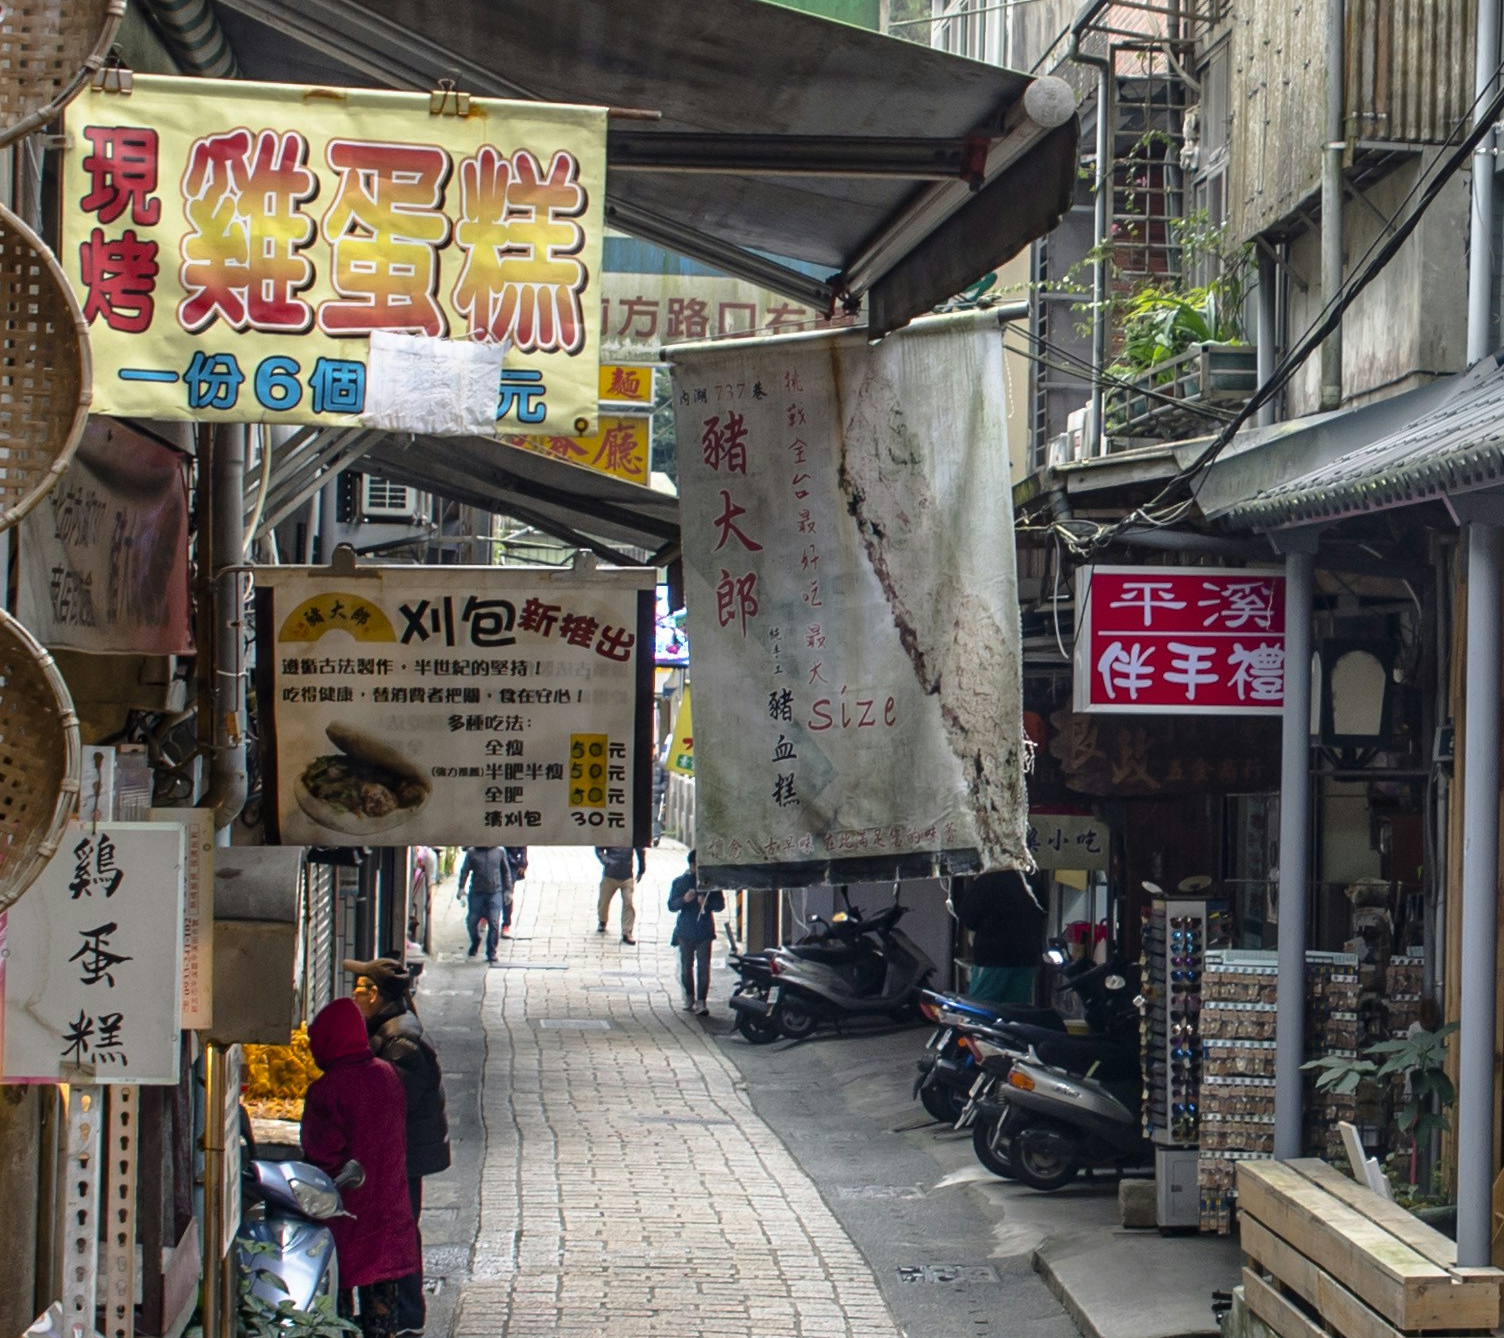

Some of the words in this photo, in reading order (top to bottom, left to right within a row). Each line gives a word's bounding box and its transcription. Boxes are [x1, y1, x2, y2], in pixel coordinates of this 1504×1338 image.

[79, 124, 161, 334] 現烤
[178, 127, 589, 354] 雞蛋糕
[700, 408, 764, 639] 豬大郎
[398, 594, 517, 648] 刈包
[516, 596, 636, 663] 新推出
[1108, 580, 1275, 633] 平溪
[1096, 640, 1285, 702] 伴手禮
[484, 785, 524, 804] 全肥
